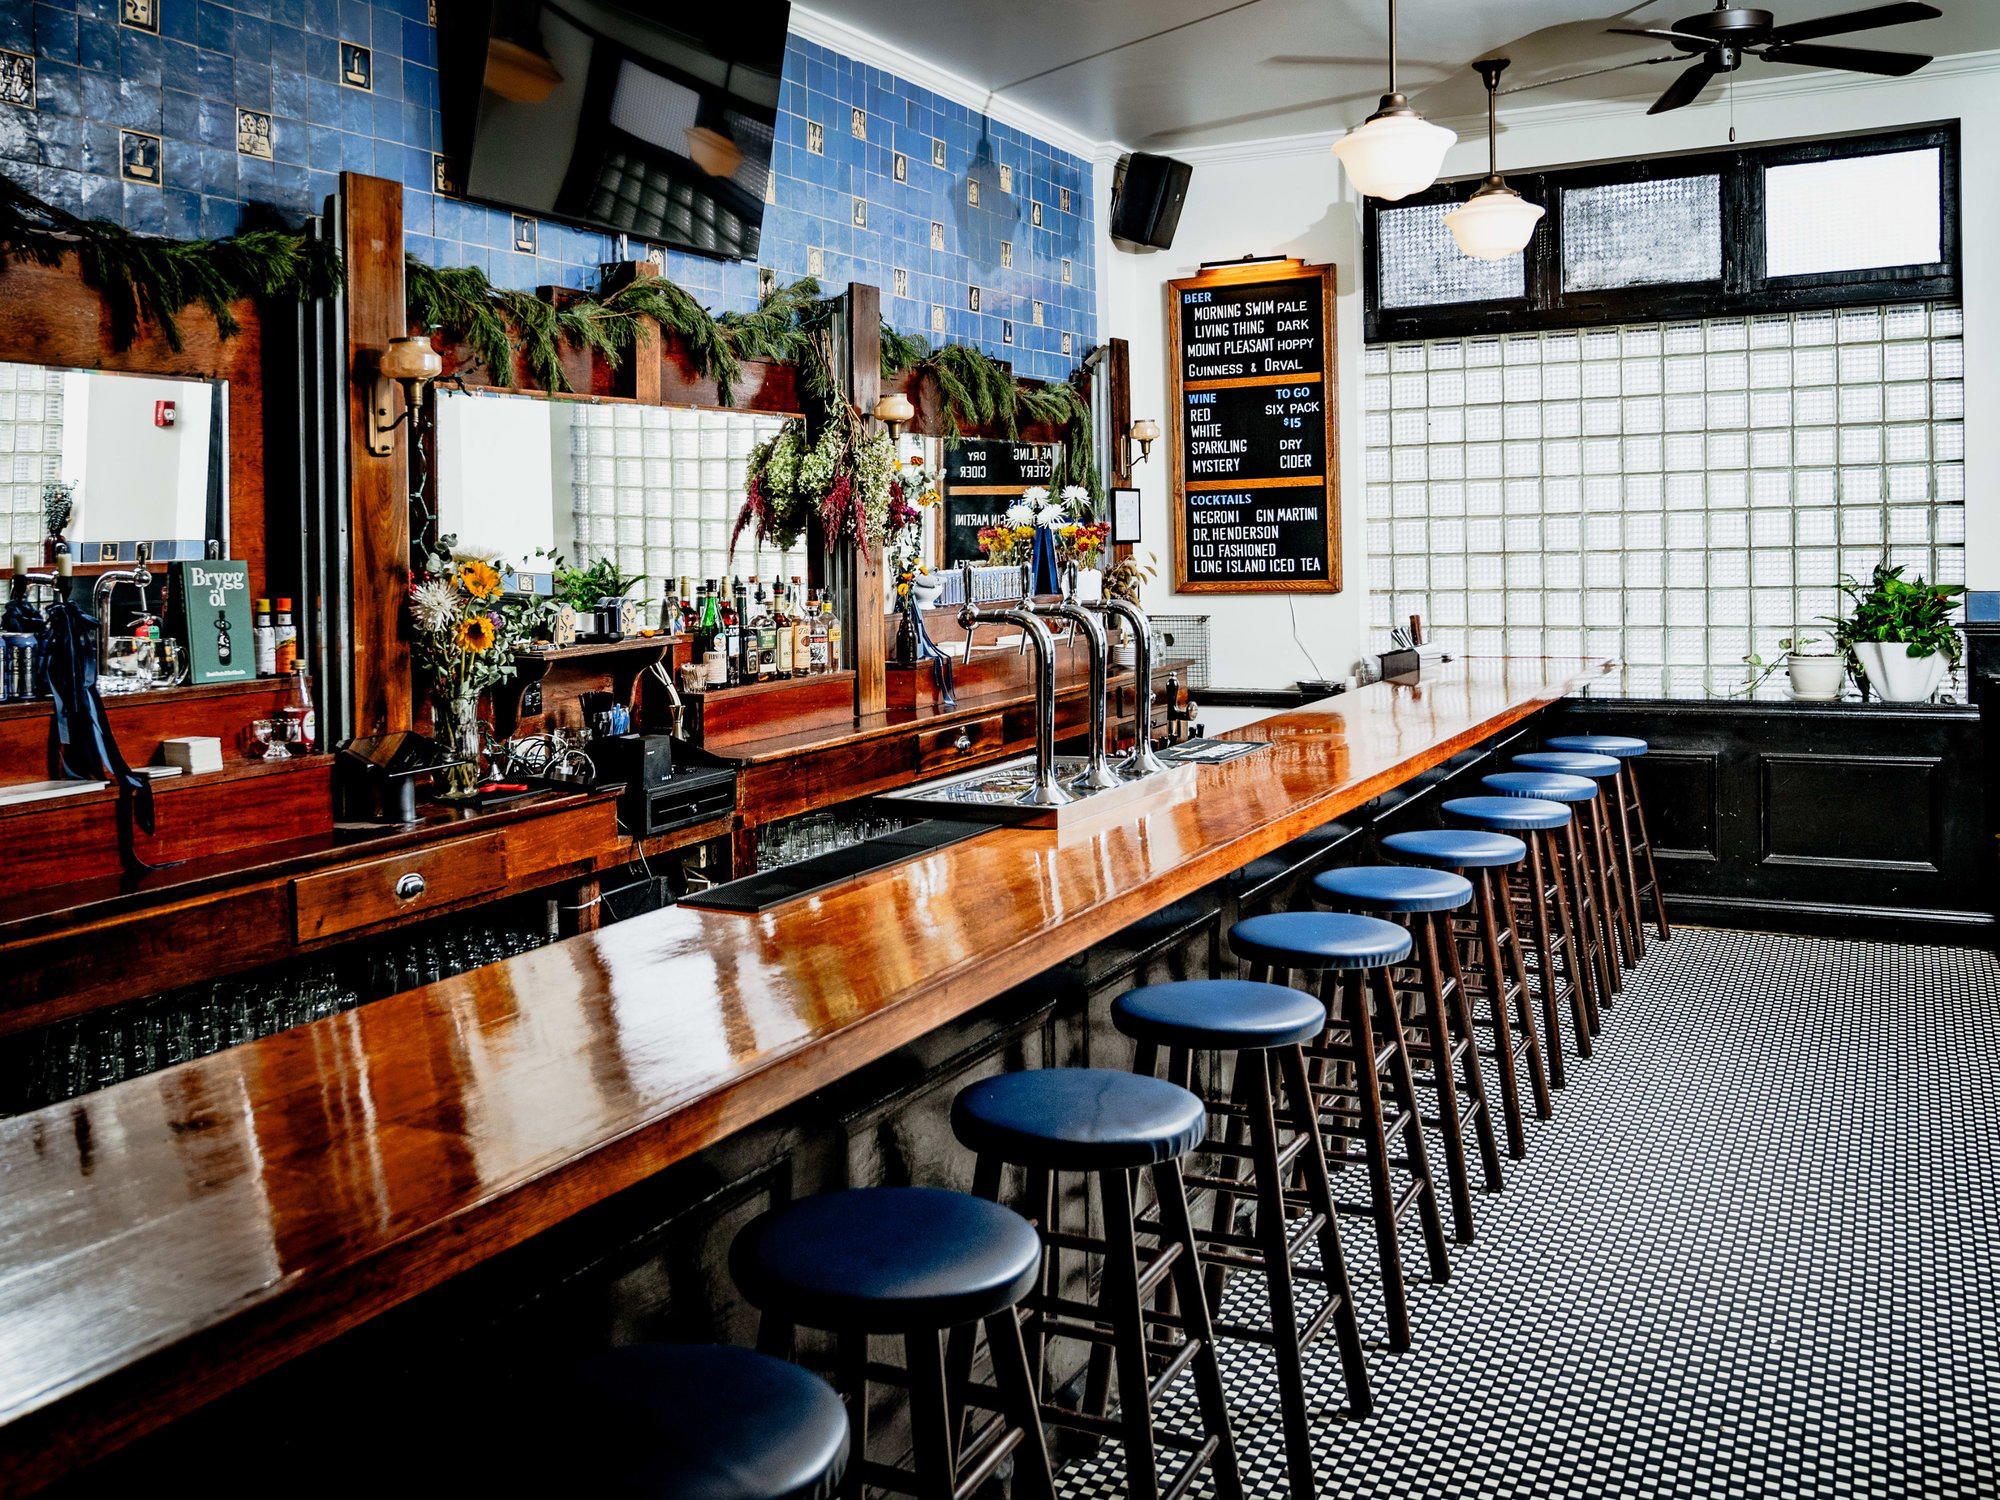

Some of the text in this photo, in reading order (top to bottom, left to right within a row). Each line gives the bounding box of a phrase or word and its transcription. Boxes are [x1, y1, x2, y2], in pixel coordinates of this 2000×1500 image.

[1185, 292, 1211, 304] BEER
[1195, 300, 1307, 321] MORNING SWIM PALE
[1195, 319, 1309, 338] LIVING THING DARK
[1188, 338, 1313, 357] MOUNT PLEASANT HOPPY
[1189, 358, 1303, 377] GUINNESS & ORVAL
[1189, 394, 1216, 404] WINE
[1276, 387, 1310, 399] TO GO
[1191, 408, 1210, 421] RED
[1266, 402, 1319, 415] SIX PACK
[1284, 418, 1301, 428] $15
[1191, 424, 1221, 437] WHITE
[1192, 439, 1247, 454] SPARKLING
[1280, 439, 1302, 450] DRY
[1193, 458, 1240, 473] MYSTERY
[1280, 454, 1311, 468] CIDER
[1191, 494, 1251, 505] COCKTAILS
[1193, 510, 1239, 524] NEGRONI
[1256, 507, 1317, 522] GIN MARTINI
[1194, 525, 1278, 541] DR. HENDERSON
[1193, 543, 1276, 557] OLD FASHIONED
[1195, 558, 1320, 573] LONG ISLAND ICED TEA
[190, 567, 245, 590] Brygg
[209, 587, 227, 607] öl
